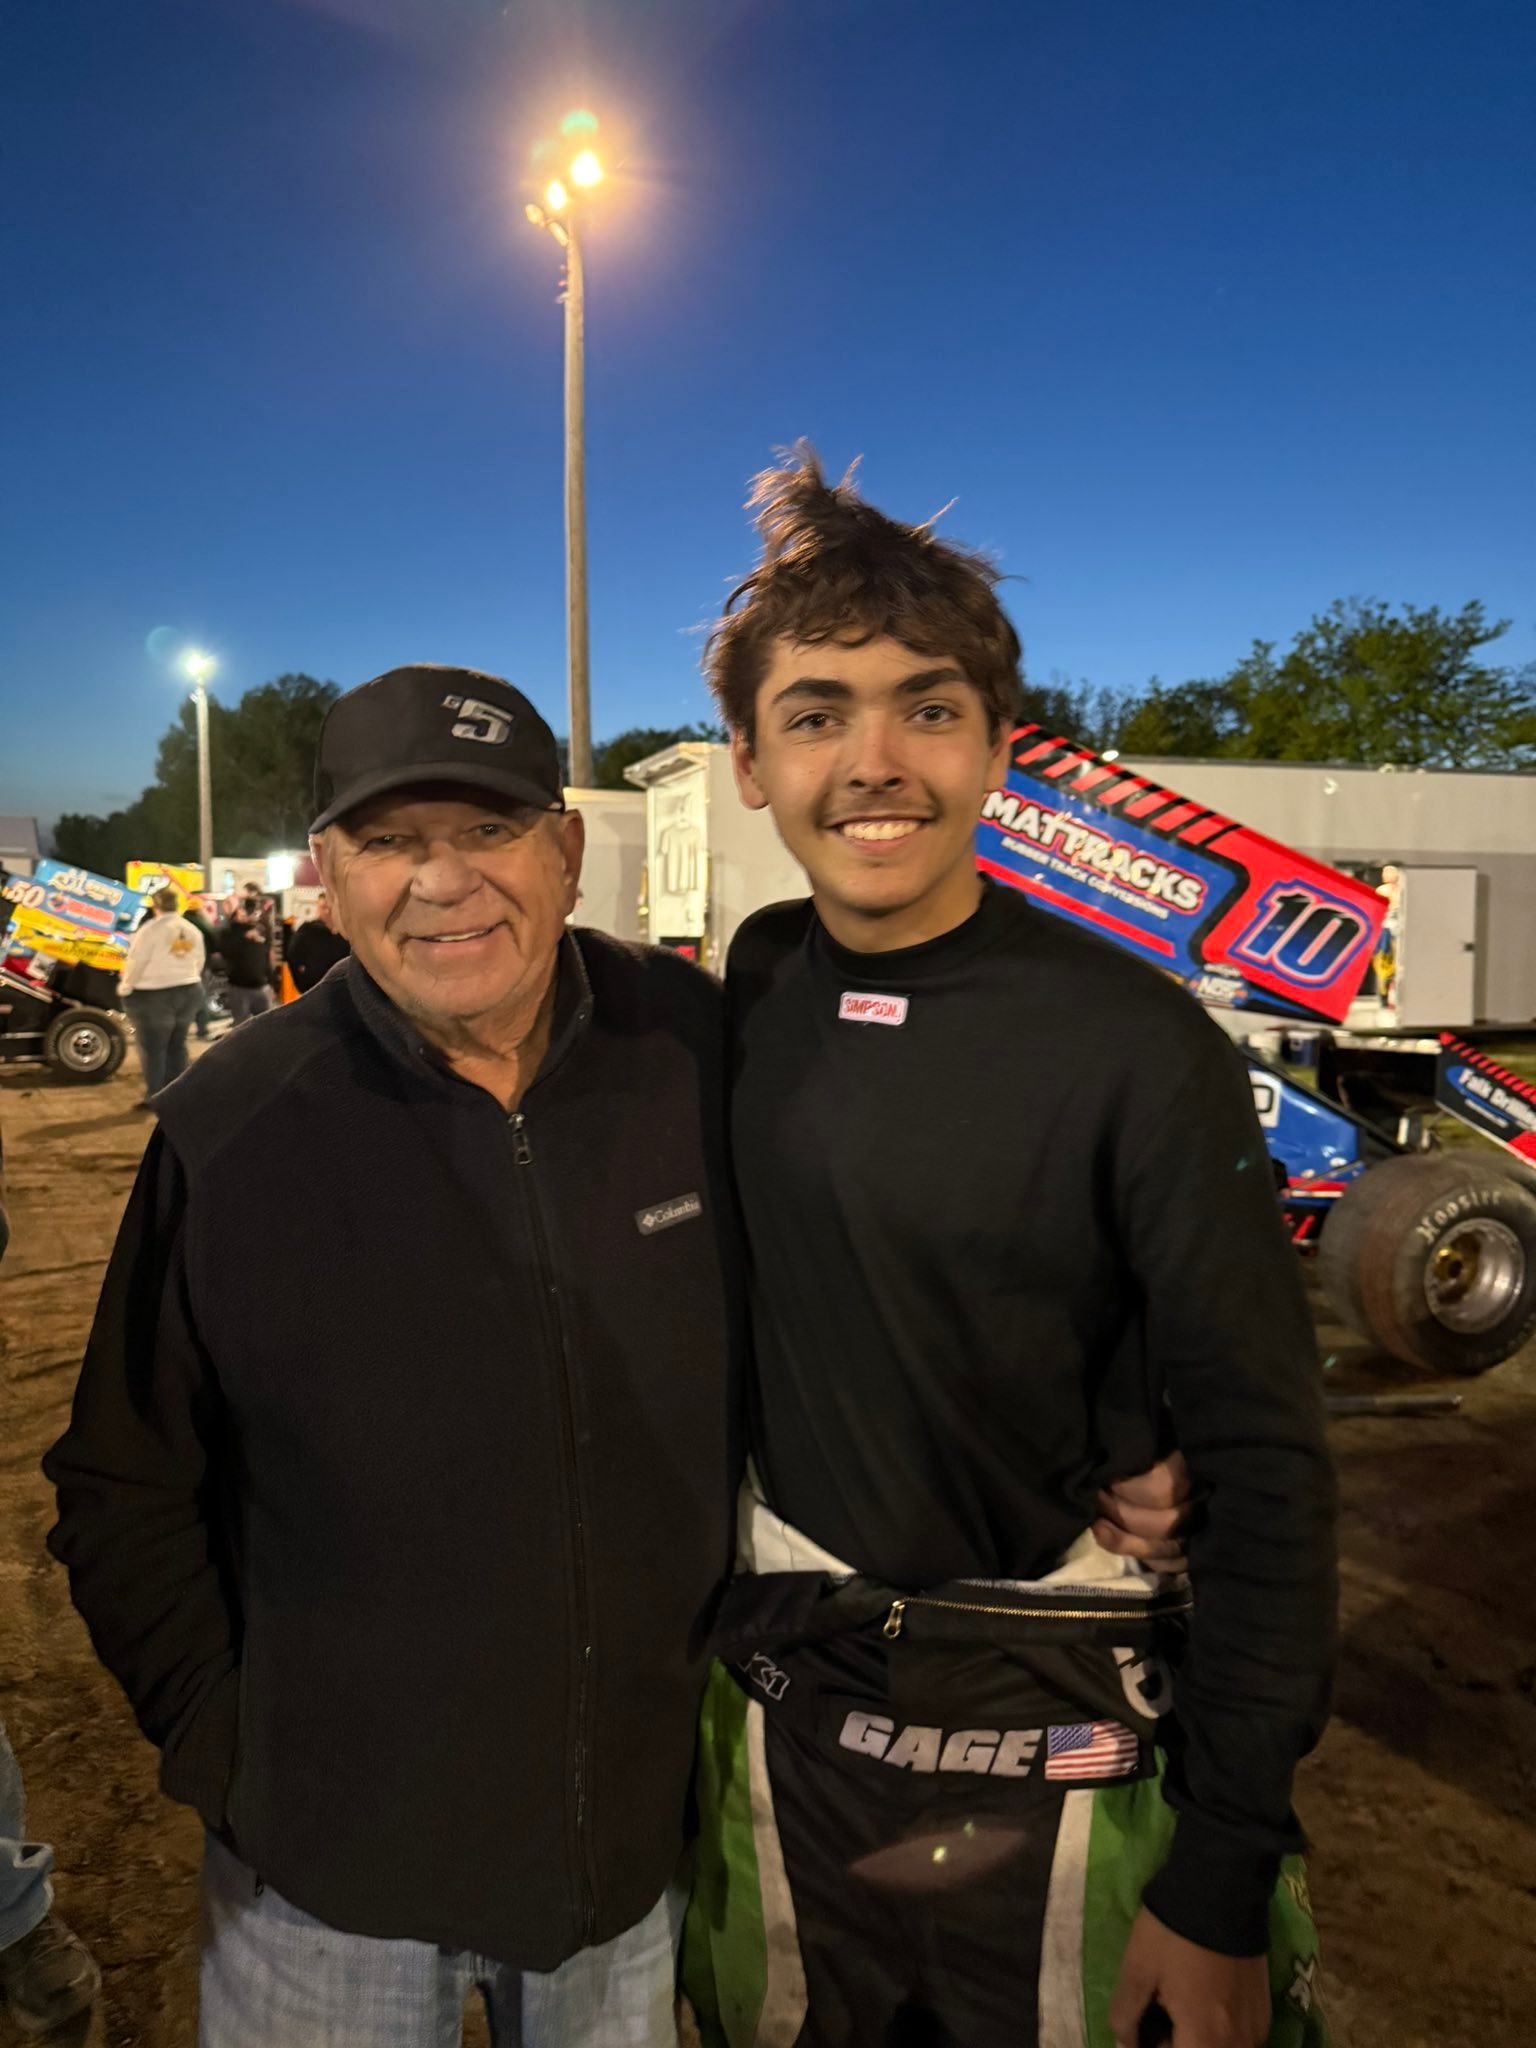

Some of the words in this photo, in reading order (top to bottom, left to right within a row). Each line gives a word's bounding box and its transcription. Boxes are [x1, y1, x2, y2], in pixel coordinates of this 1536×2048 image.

[980, 790, 1204, 911] MATTRACKS
[1236, 886, 1369, 983] 10
[845, 998, 898, 1018] SIMPSON
[838, 1709, 1043, 1777] GAGE
